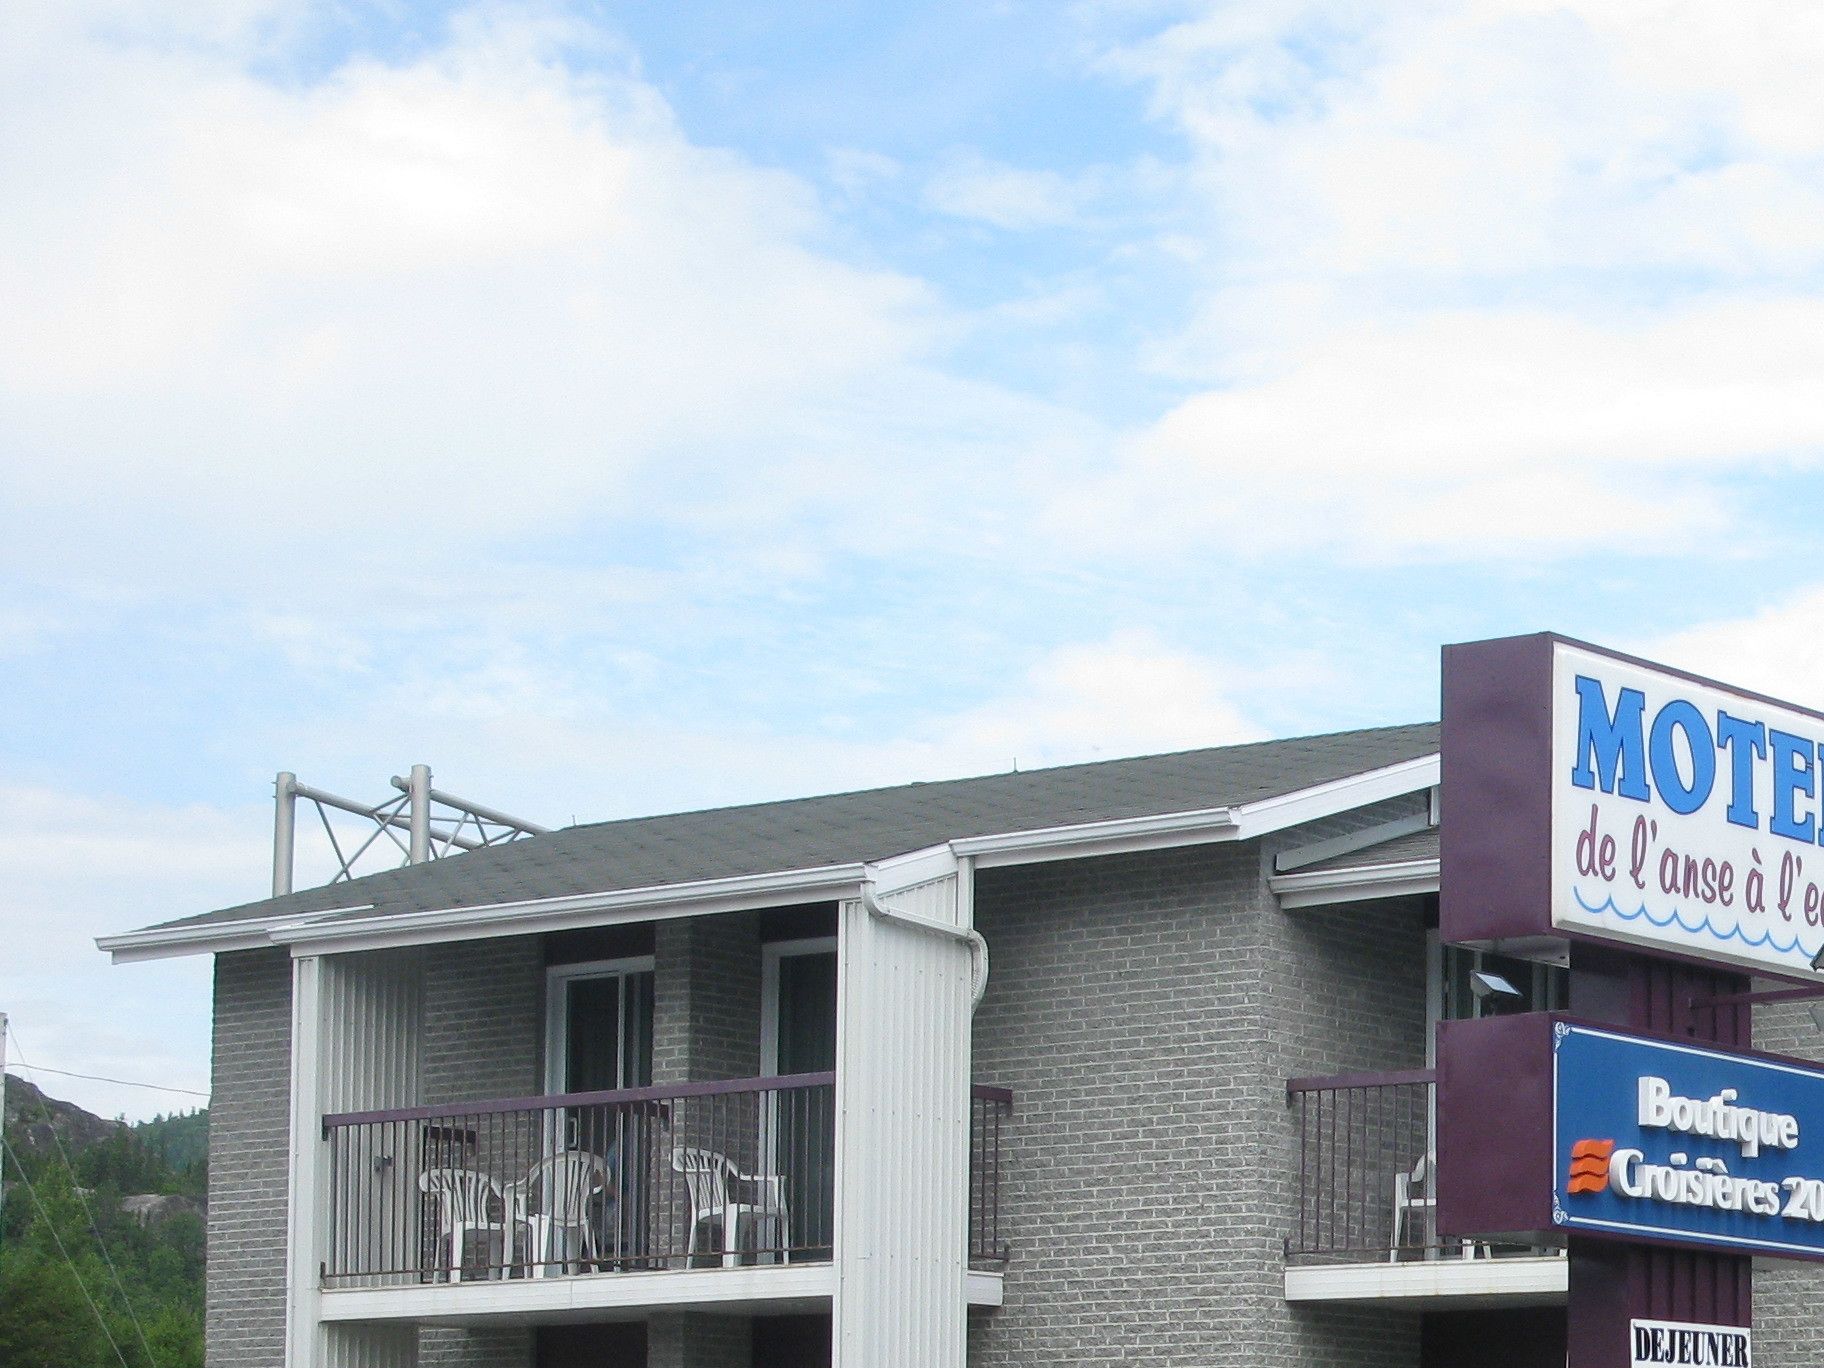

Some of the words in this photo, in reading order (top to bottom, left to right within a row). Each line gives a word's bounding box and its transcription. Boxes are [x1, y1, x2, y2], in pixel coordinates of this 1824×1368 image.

[1576, 803, 1616, 882] de
[1629, 813, 1734, 904] l'anse
[1746, 847, 1766, 912] à
[1637, 1075, 1800, 1158] Boutique
[1609, 1147, 1781, 1217] Croisières
[1634, 1326, 1749, 1368] DEJEUNER
